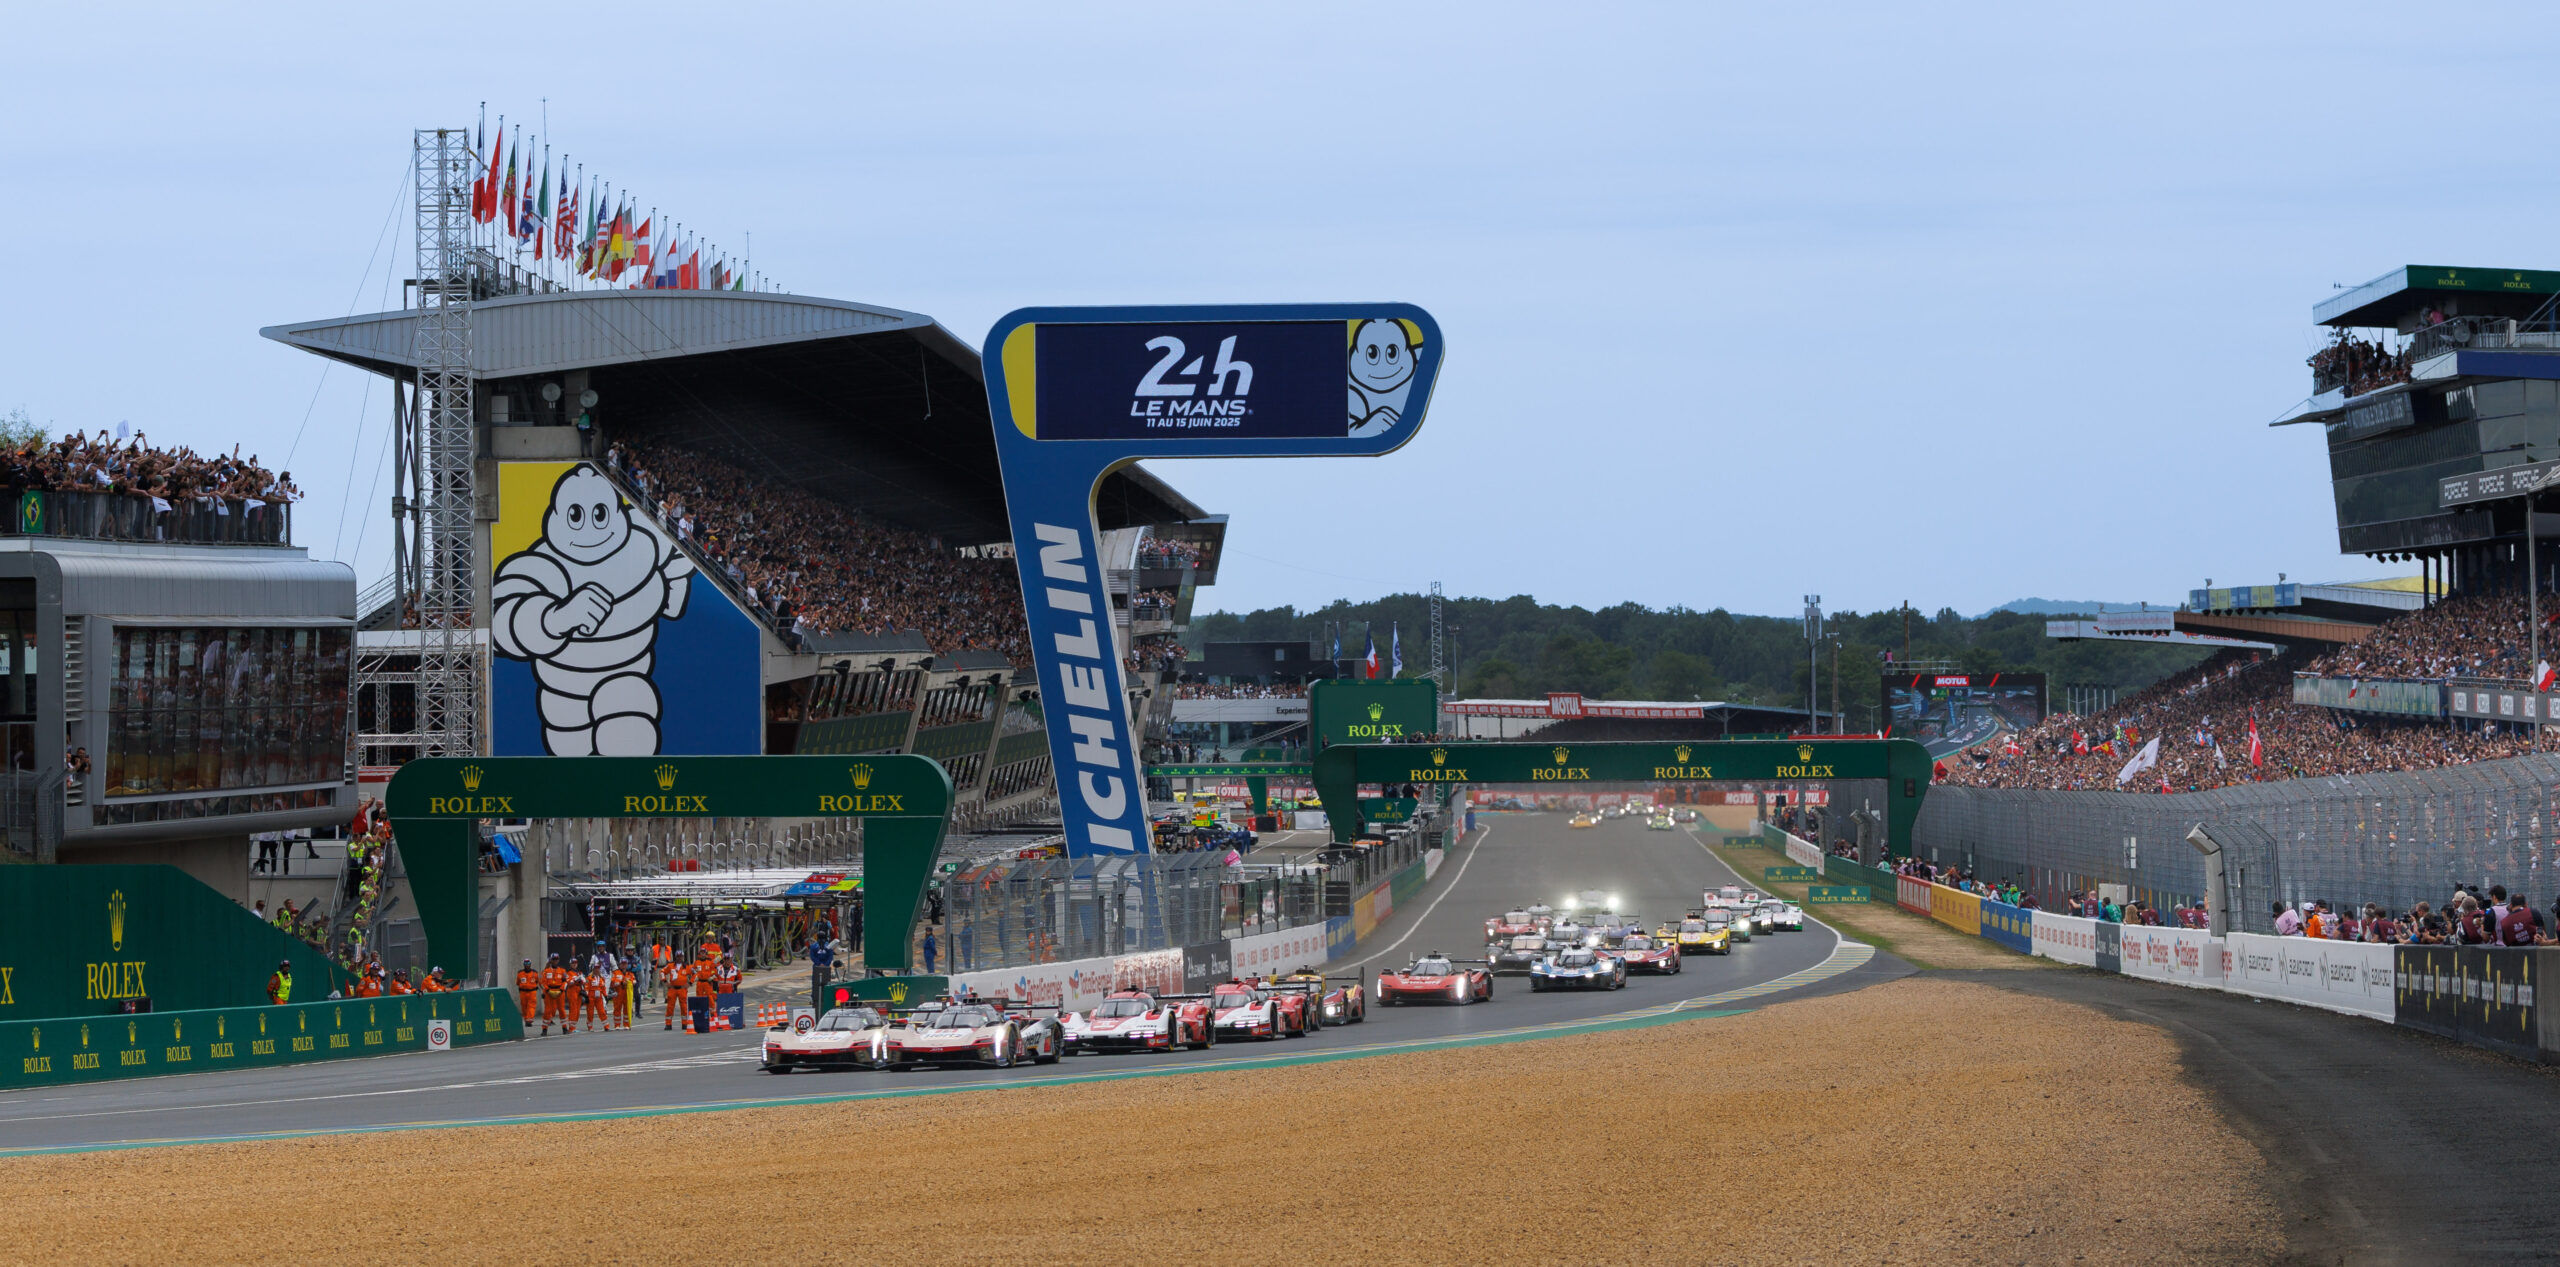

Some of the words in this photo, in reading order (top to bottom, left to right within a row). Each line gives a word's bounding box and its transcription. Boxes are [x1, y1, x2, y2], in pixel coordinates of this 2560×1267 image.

[2504, 281, 2531, 289] ROLEX
[1130, 400, 1164, 416] LE
[1168, 399, 1246, 416] MANS
[1146, 418, 1156, 428] 11
[1157, 418, 1174, 427] AU
[1176, 418, 1187, 427] 15
[1187, 417, 1212, 429] JUIN
[1213, 417, 1241, 427] 2025
[1936, 677, 1967, 685] MOTUL
[1551, 696, 1581, 716] MOTUL
[1348, 724, 1403, 737] ROLEX
[1410, 769, 1469, 781] ROLEX
[1532, 768, 1590, 780] ROLEX
[1654, 766, 1712, 778] ROLEX
[1776, 765, 1834, 777] ROLEX
[430, 797, 514, 814] ROLEX
[624, 795, 709, 812] ROLEX
[818, 794, 904, 811] ROLEX
[1725, 793, 1755, 804] MOTUL
[87, 962, 147, 999] ROLEX
[798, 1020, 811, 1029] 60
[434, 1031, 444, 1040] 60
[24, 1056, 51, 1073] ROLEX
[73, 1053, 100, 1070] ROLEX
[120, 1049, 146, 1066] ROLEX
[166, 1046, 192, 1062] ROLEX
[210, 1042, 235, 1058] ROLEX
[252, 1039, 275, 1055] ROLEX
[292, 1036, 314, 1052] ROLEX
[330, 1033, 350, 1049] ROLEX
[364, 1030, 384, 1046] ROLEX
